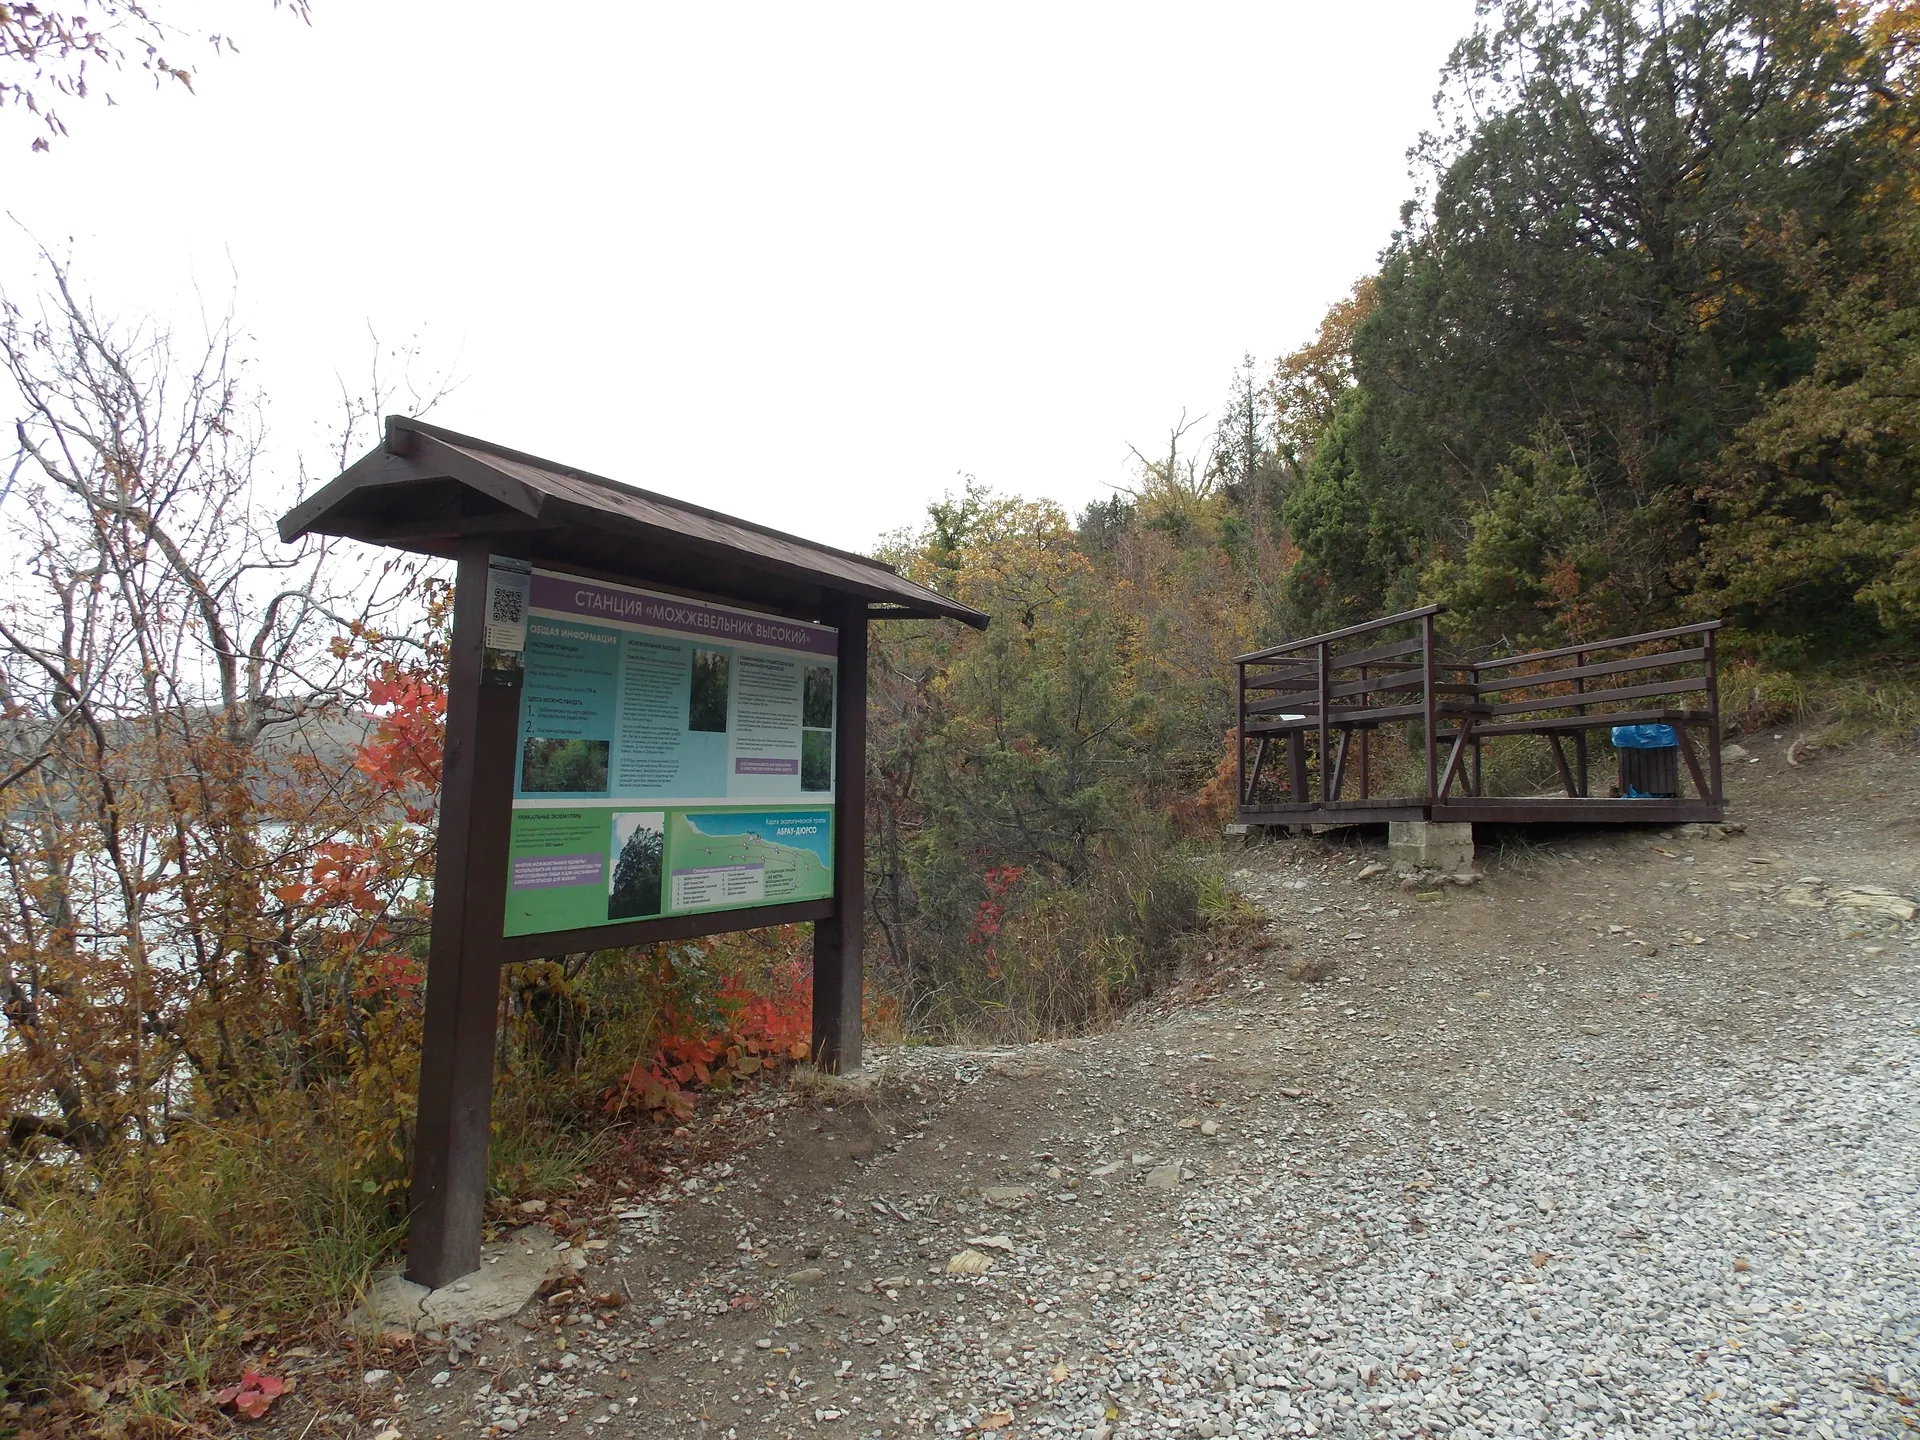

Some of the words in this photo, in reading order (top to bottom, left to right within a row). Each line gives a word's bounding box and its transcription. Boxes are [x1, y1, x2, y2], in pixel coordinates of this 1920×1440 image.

[575, 590, 642, 616] СТАНЦИЯ
[646, 606, 752, 636] «МОЖЖЕВЕЛЬНИК
[756, 624, 812, 644] ВЫСОКИЙ»
[530, 624, 560, 636] ОБЩАЯ
[561, 629, 617, 644] ИНФОРМАЦИЯ
[525, 720, 535, 733] 2.
[776, 826, 818, 836] АБРАУ-ДЮРСО
